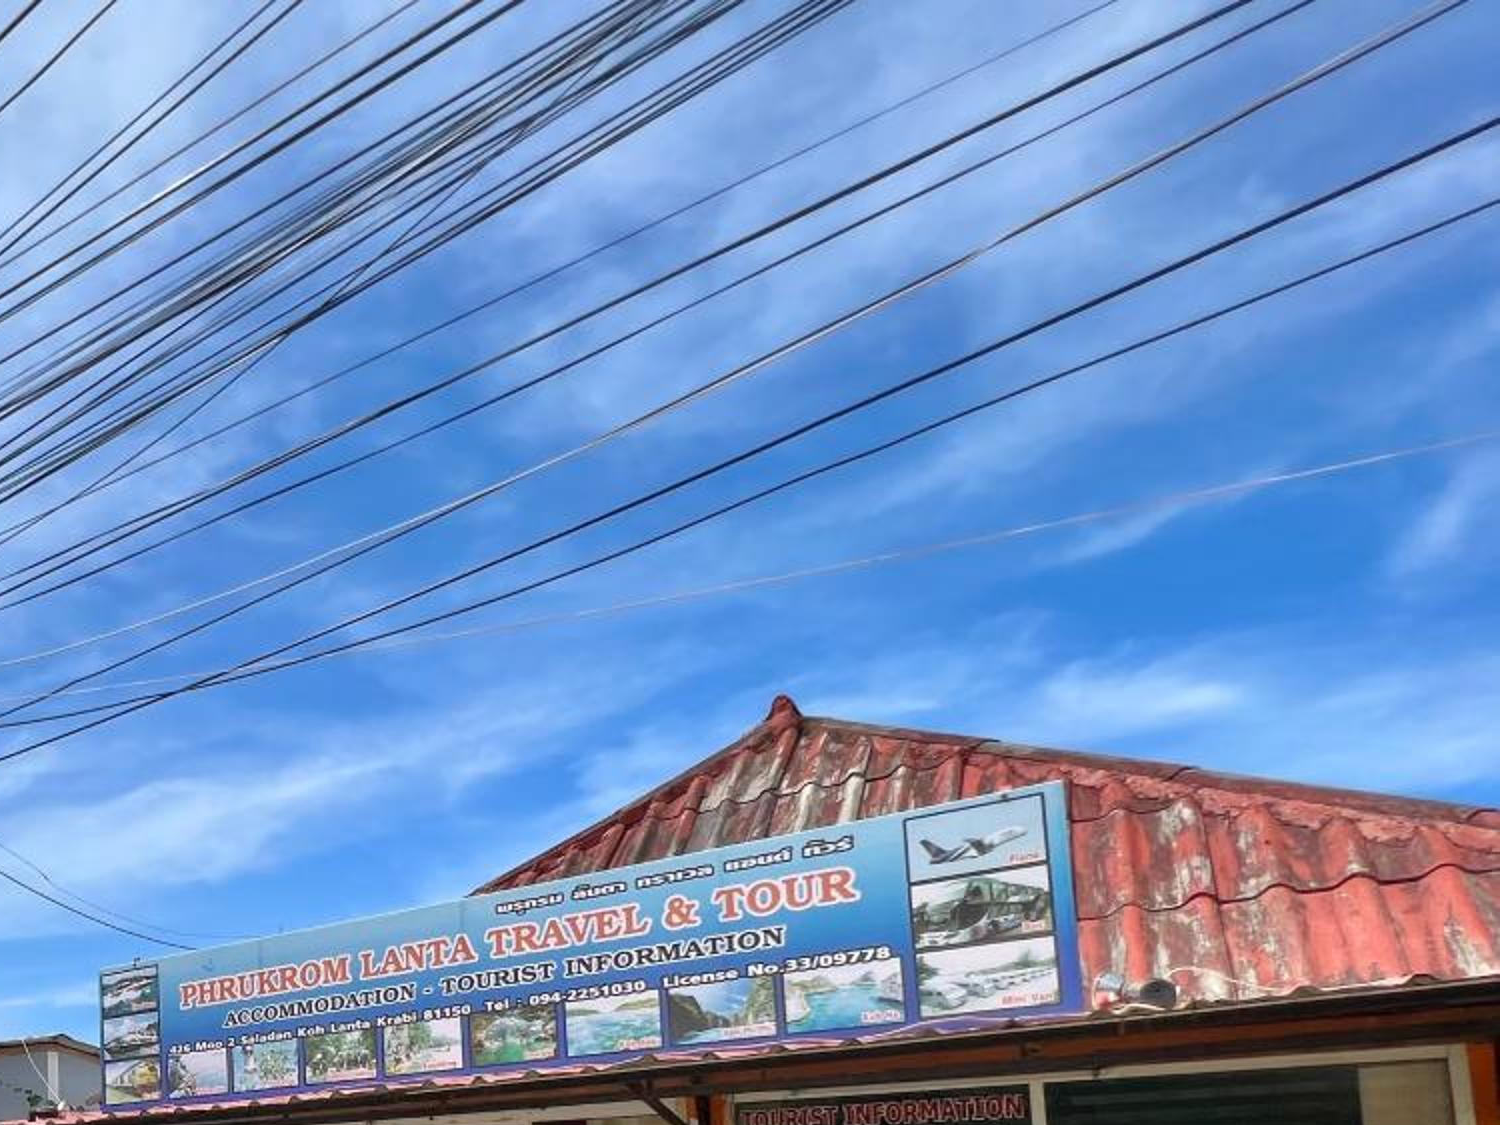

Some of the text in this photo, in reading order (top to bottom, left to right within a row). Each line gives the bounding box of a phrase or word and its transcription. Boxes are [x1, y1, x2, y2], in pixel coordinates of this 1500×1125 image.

[179, 865, 862, 1011] PHRUKROM LANTA TRAVEL & TOUR
[222, 980, 416, 1030] ACCOMMODATION
[438, 961, 556, 995] TOURIST
[564, 925, 787, 978] INFORMATION
[195, 1040, 224, 1052] Moo
[227, 1036, 236, 1048] 2
[241, 1029, 293, 1045] Saladan
[297, 1024, 325, 1038] Koh
[331, 1018, 371, 1033] Lanta
[377, 1013, 418, 1028] Krabi
[423, 1003, 472, 1022] 81150
[484, 998, 510, 1013] Tel
[528, 979, 647, 1007] 094-2251030
[662, 967, 739, 989] License
[746, 945, 892, 978] No.33/09778
